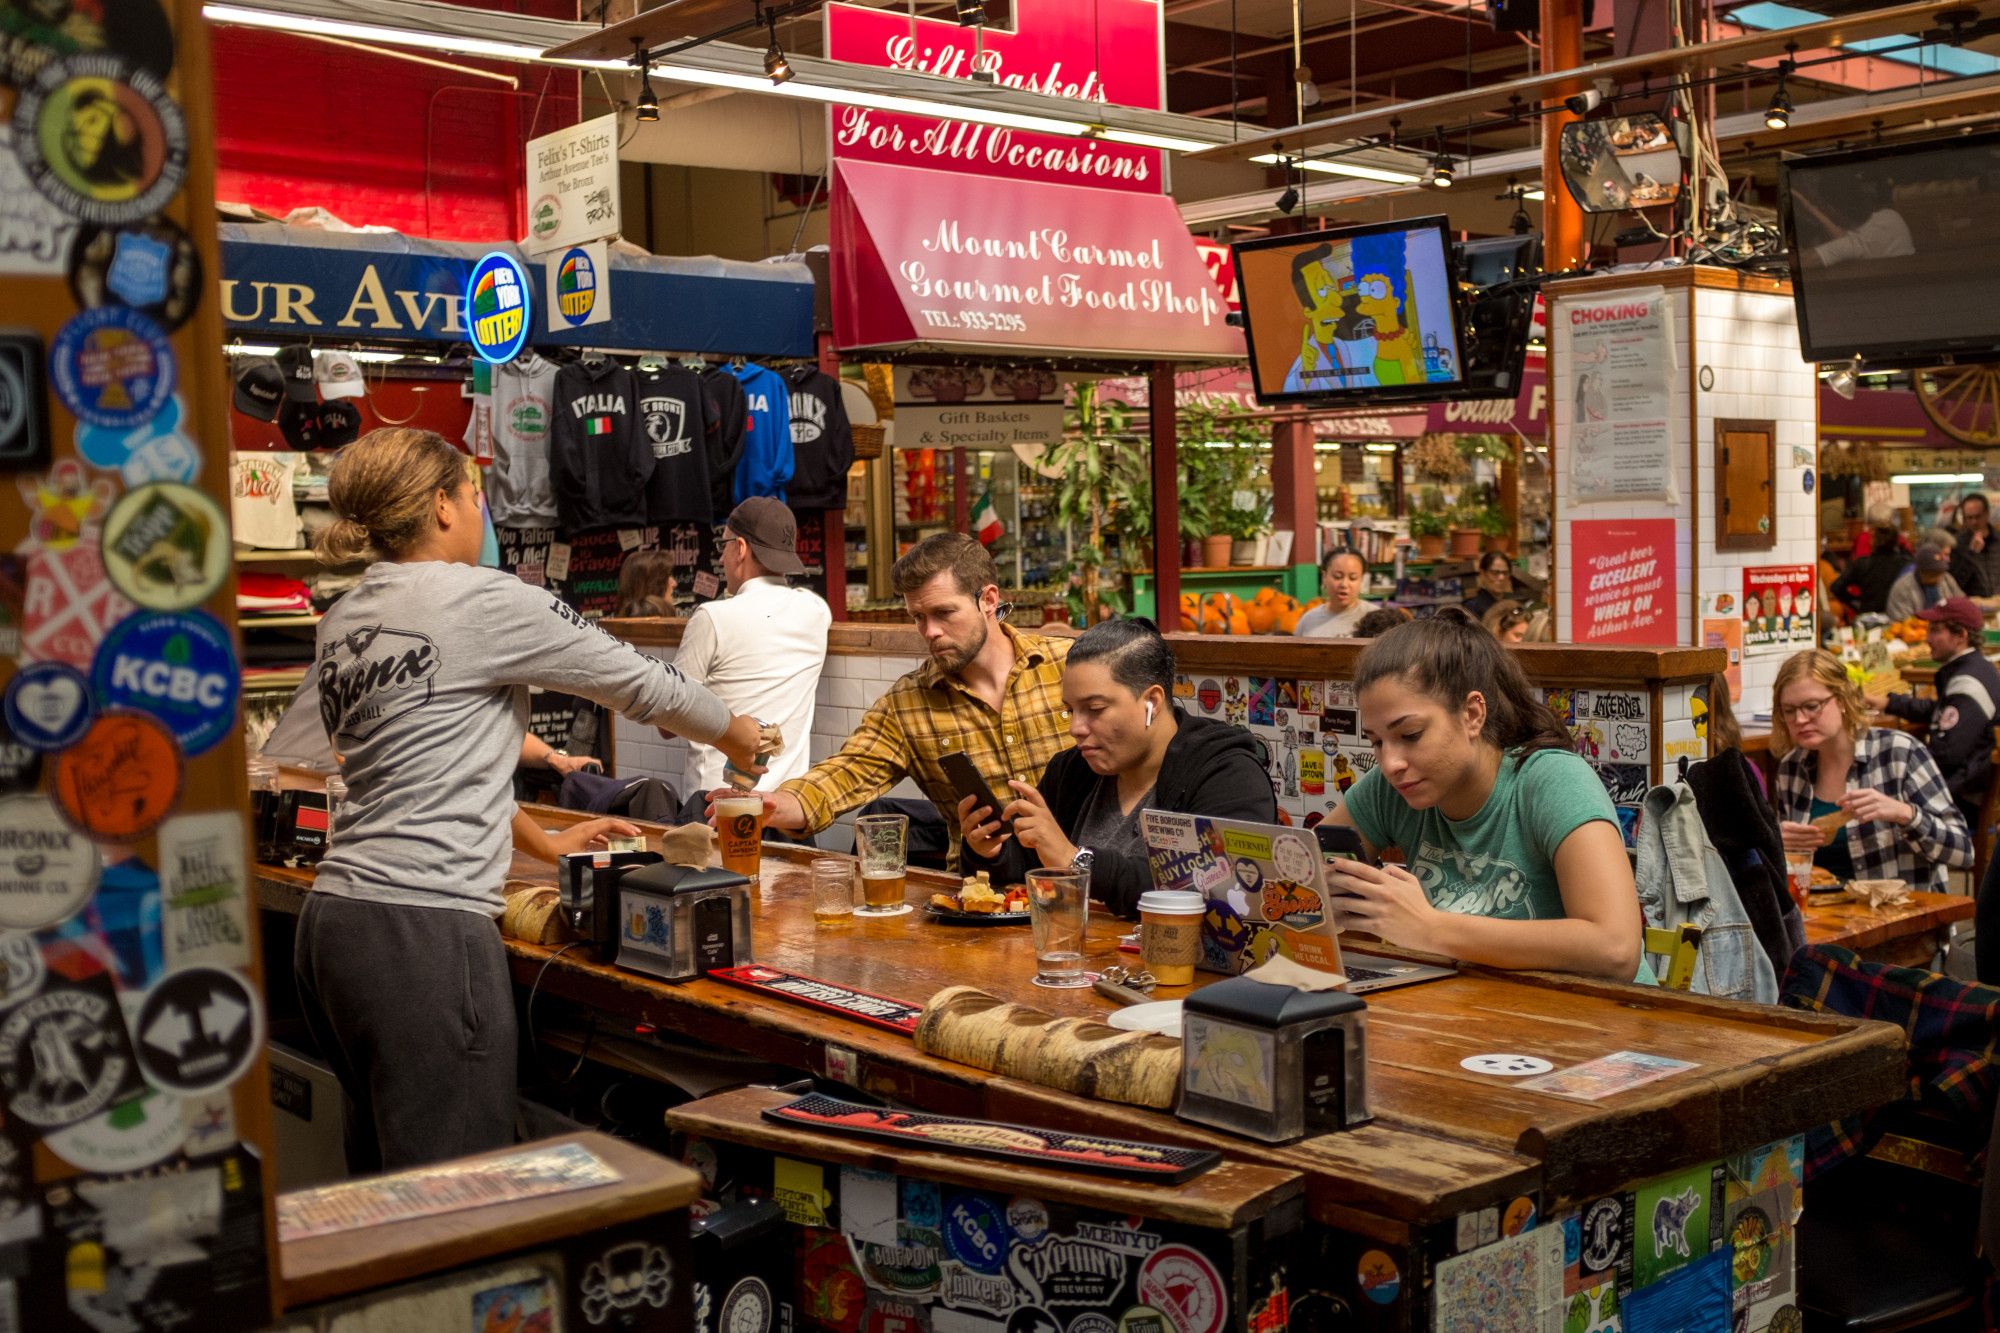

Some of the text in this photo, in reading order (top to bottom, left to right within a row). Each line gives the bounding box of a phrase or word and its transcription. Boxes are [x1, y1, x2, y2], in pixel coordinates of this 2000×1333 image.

[885, 34, 966, 80] Gift
[537, 134, 610, 168] Felix's T-Shirts
[838, 107, 1150, 181] For All Occasions
[539, 167, 562, 183] Arthur
[564, 160, 589, 175] Avenue
[557, 175, 594, 194] The Bronx
[922, 219, 1164, 270] Mount Carmel
[494, 268, 515, 286] NEW
[496, 284, 522, 310] YORK
[559, 288, 594, 317] LOTTERY
[900, 260, 1220, 326] Gourmet Food Shop
[920, 310, 1028, 332] TEL: 933-2295
[1571, 302, 1648, 325] CHOKING
[474, 307, 523, 346] LOTTERY
[572, 394, 626, 418] ITALIA
[652, 402, 680, 415] BRONX
[939, 410, 1031, 425] Gift Baskets
[920, 429, 1049, 445] & Specialty Items
[1589, 560, 1657, 591] EXCELLENT
[1593, 595, 1653, 623] WHEN ON
[1587, 620, 1628, 639] Arthur
[111, 654, 227, 708] KCBC
[318, 644, 434, 748] Bronx
[1301, 769, 1324, 778] UPTOWN
[1302, 761, 1317, 769] SAVE
[1146, 814, 1191, 828] FIVE BOROUGHS
[1148, 825, 1175, 836] BREWING
[1150, 849, 1173, 868] BUY
[1158, 864, 1181, 884] BUY
[1299, 944, 1322, 955] DRINK
[952, 1203, 998, 1261] KCBC
[874, 1246, 941, 1268] BLUE POINT
[1008, 1240, 1121, 1306] SIXPOINT
[1053, 1284, 1105, 1295] BREWERY
